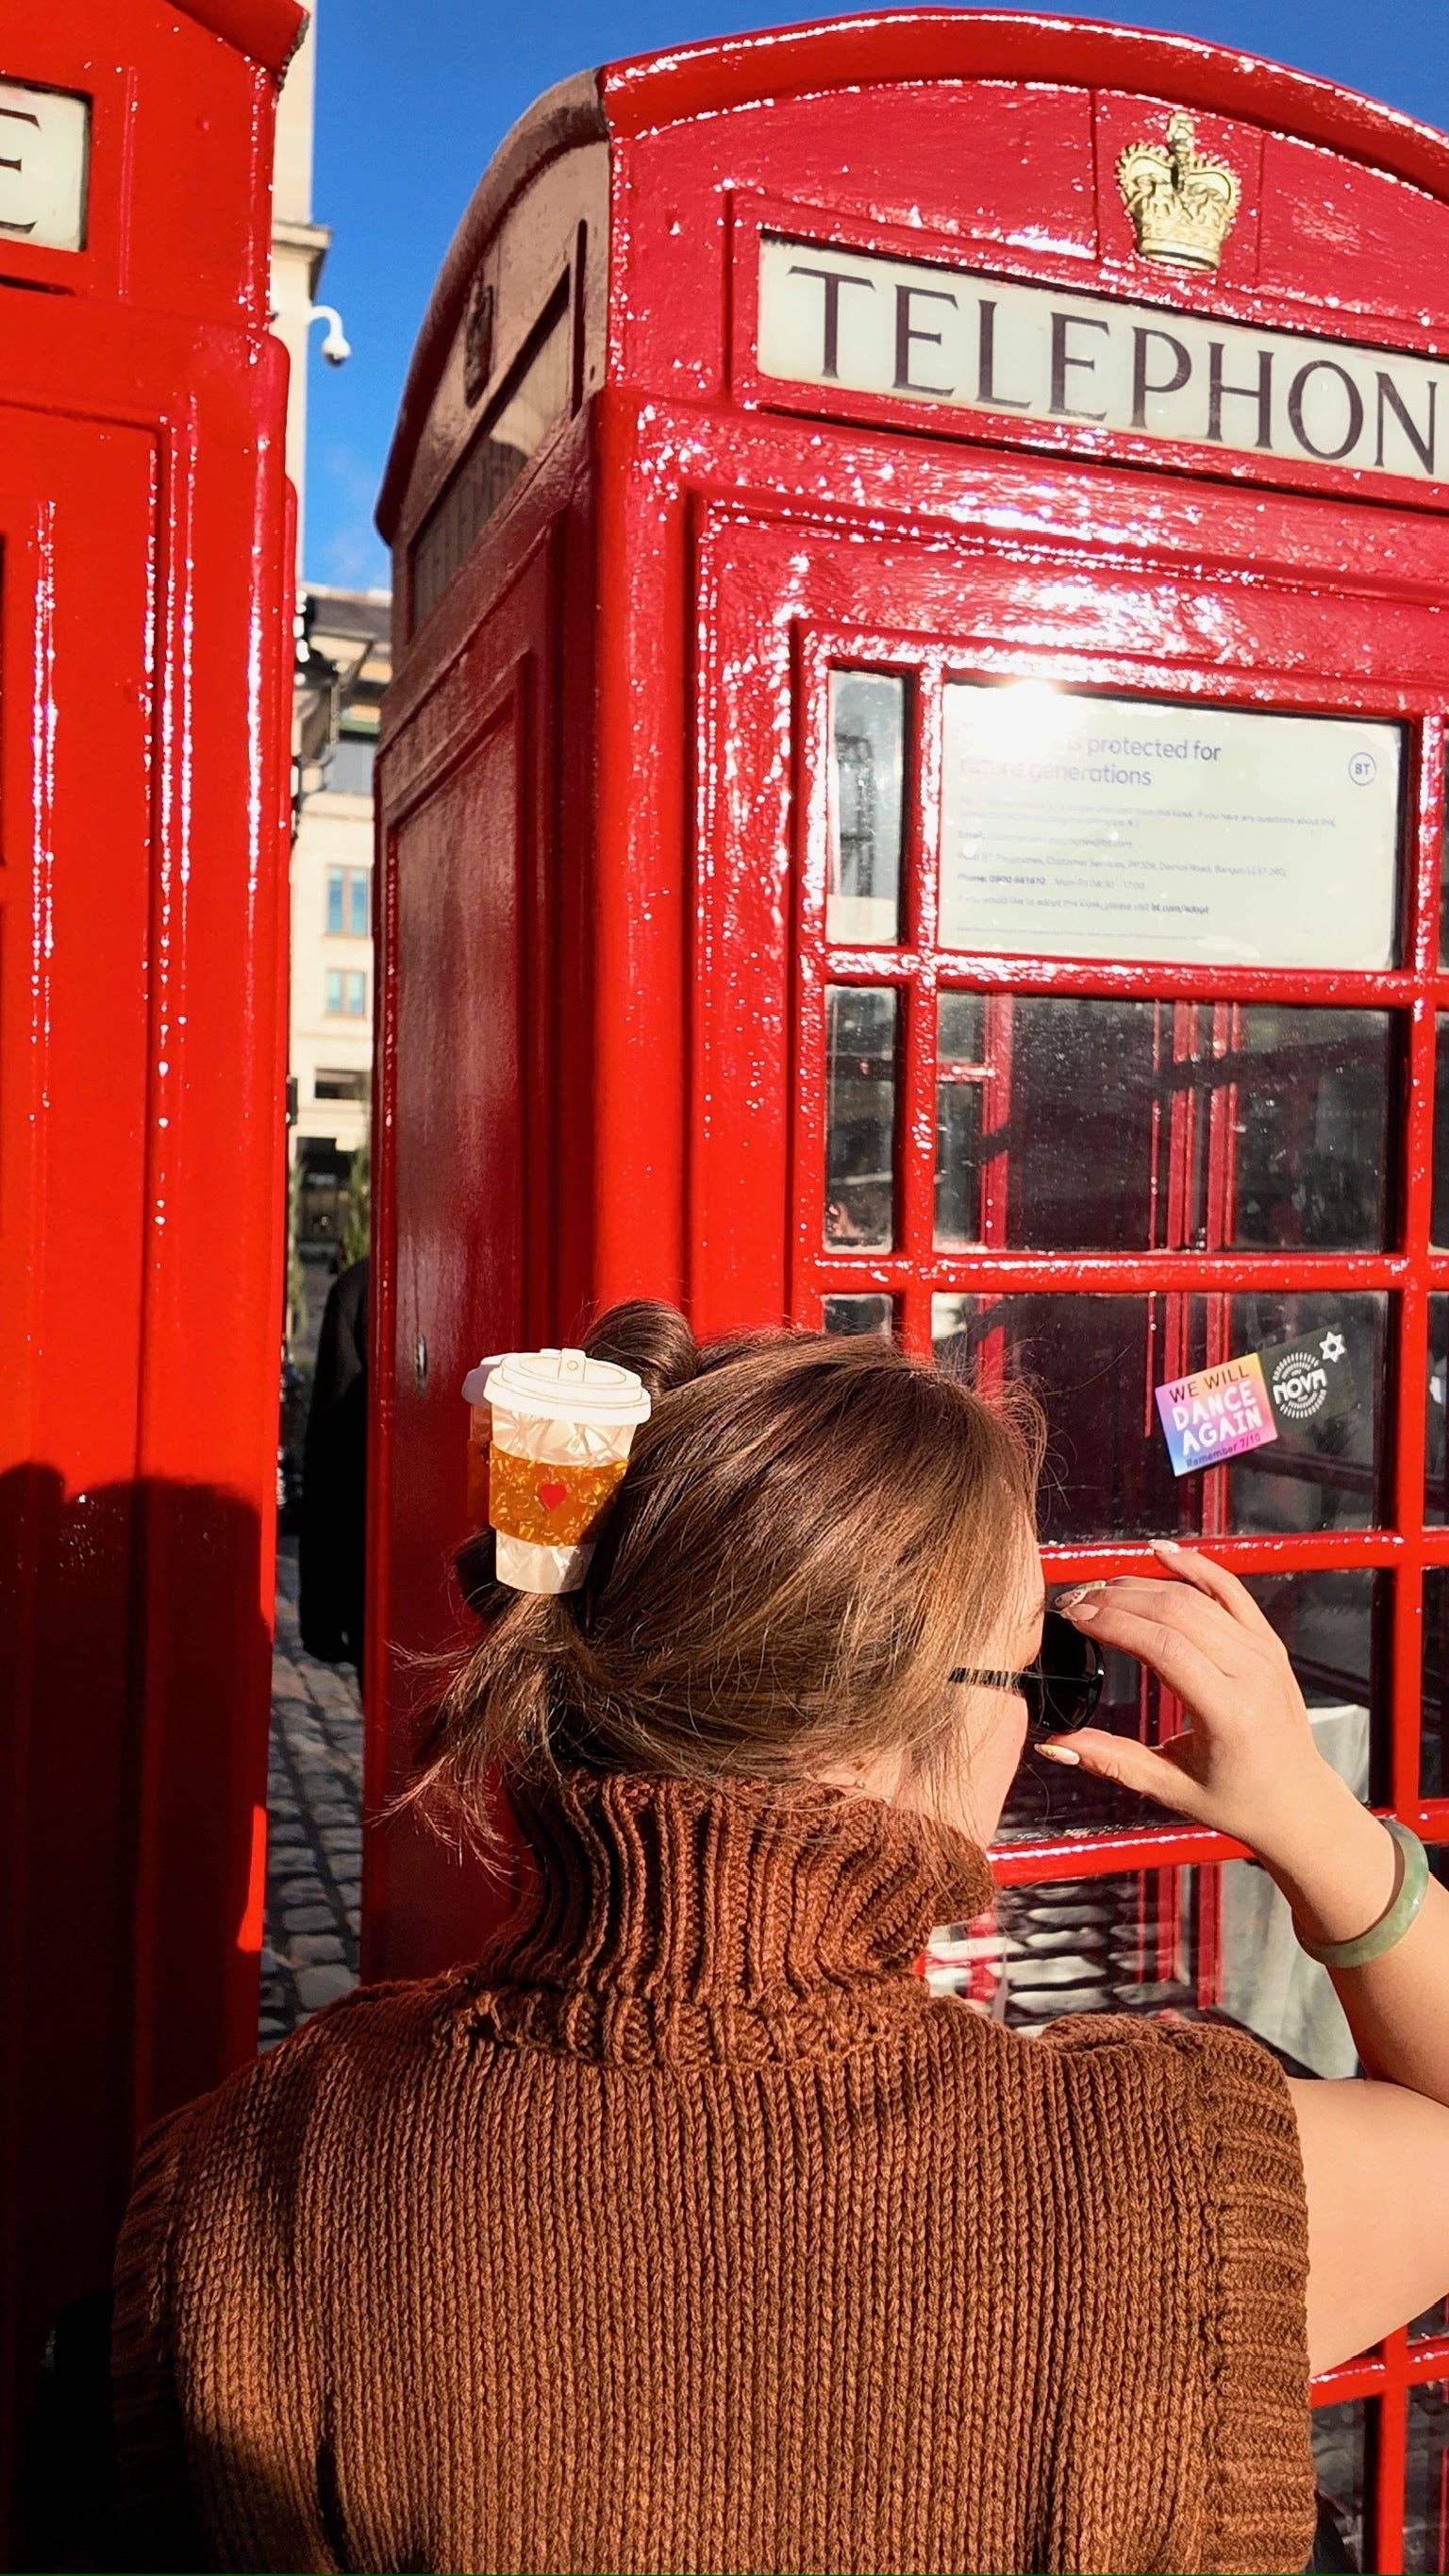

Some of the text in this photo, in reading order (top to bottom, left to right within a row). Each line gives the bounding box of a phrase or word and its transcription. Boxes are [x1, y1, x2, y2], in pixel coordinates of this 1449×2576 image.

[789, 265, 1438, 476] TELEPHON
[1087, 737, 1188, 760] protected
[1193, 740, 1222, 761] for
[1027, 763, 1153, 787] generations
[1355, 762, 1371, 776] BT
[1169, 1364, 1250, 1404] WE WILL
[1273, 1368, 1328, 1405] NOVA
[1172, 1380, 1257, 1431] DANCE
[1182, 1407, 1263, 1457] AGAIN
[1186, 1432, 1261, 1468] Remember 7/10
